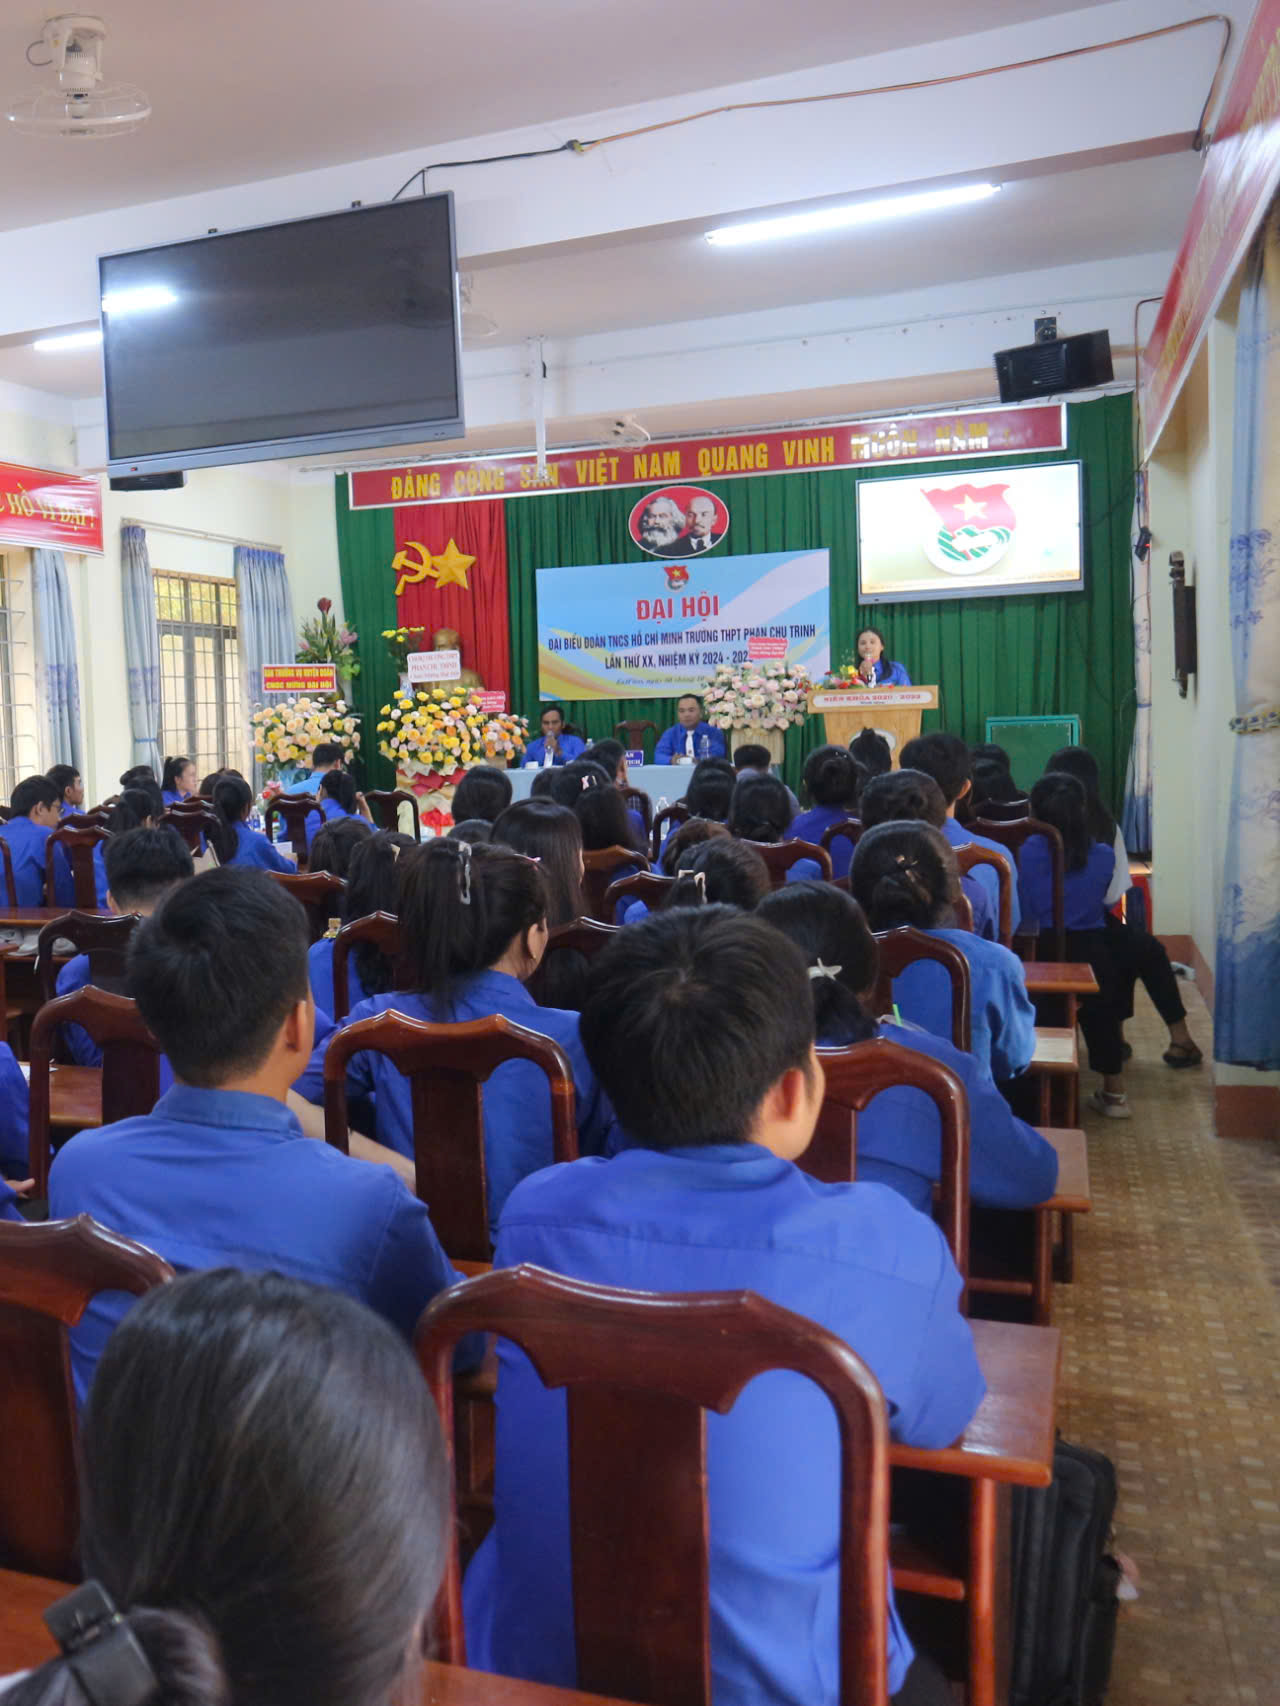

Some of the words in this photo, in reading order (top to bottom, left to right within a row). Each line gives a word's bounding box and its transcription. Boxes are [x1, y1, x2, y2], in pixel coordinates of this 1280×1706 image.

[391, 468, 441, 499] ĐẢNG
[453, 467, 505, 496] CỘNG
[575, 452, 619, 485] VIỆT
[633, 450, 681, 479] NAM
[698, 443, 768, 476] QUANG
[782, 436, 835, 465] VINH
[6, 483, 34, 517] HỒ
[636, 599, 673, 624] ĐẠI
[682, 591, 719, 621] HỘI
[548, 638, 562, 653] ĐẠI
[564, 632, 582, 650] BIỂU
[584, 633, 606, 649] ĐOÀN
[608, 634, 629, 648] TNCS
[631, 629, 642, 646] HỒ
[661, 631, 683, 644] MINH
[686, 627, 718, 643] TRƯỜNG
[721, 628, 742, 642] THPT
[744, 625, 767, 640] PHAN
[769, 625, 787, 638] CHU
[790, 623, 816, 638] TRINH
[624, 653, 641, 668] THỨ
[658, 651, 686, 669] NHIỆM
[702, 651, 723, 665] 2024
[732, 649, 754, 664] 202
